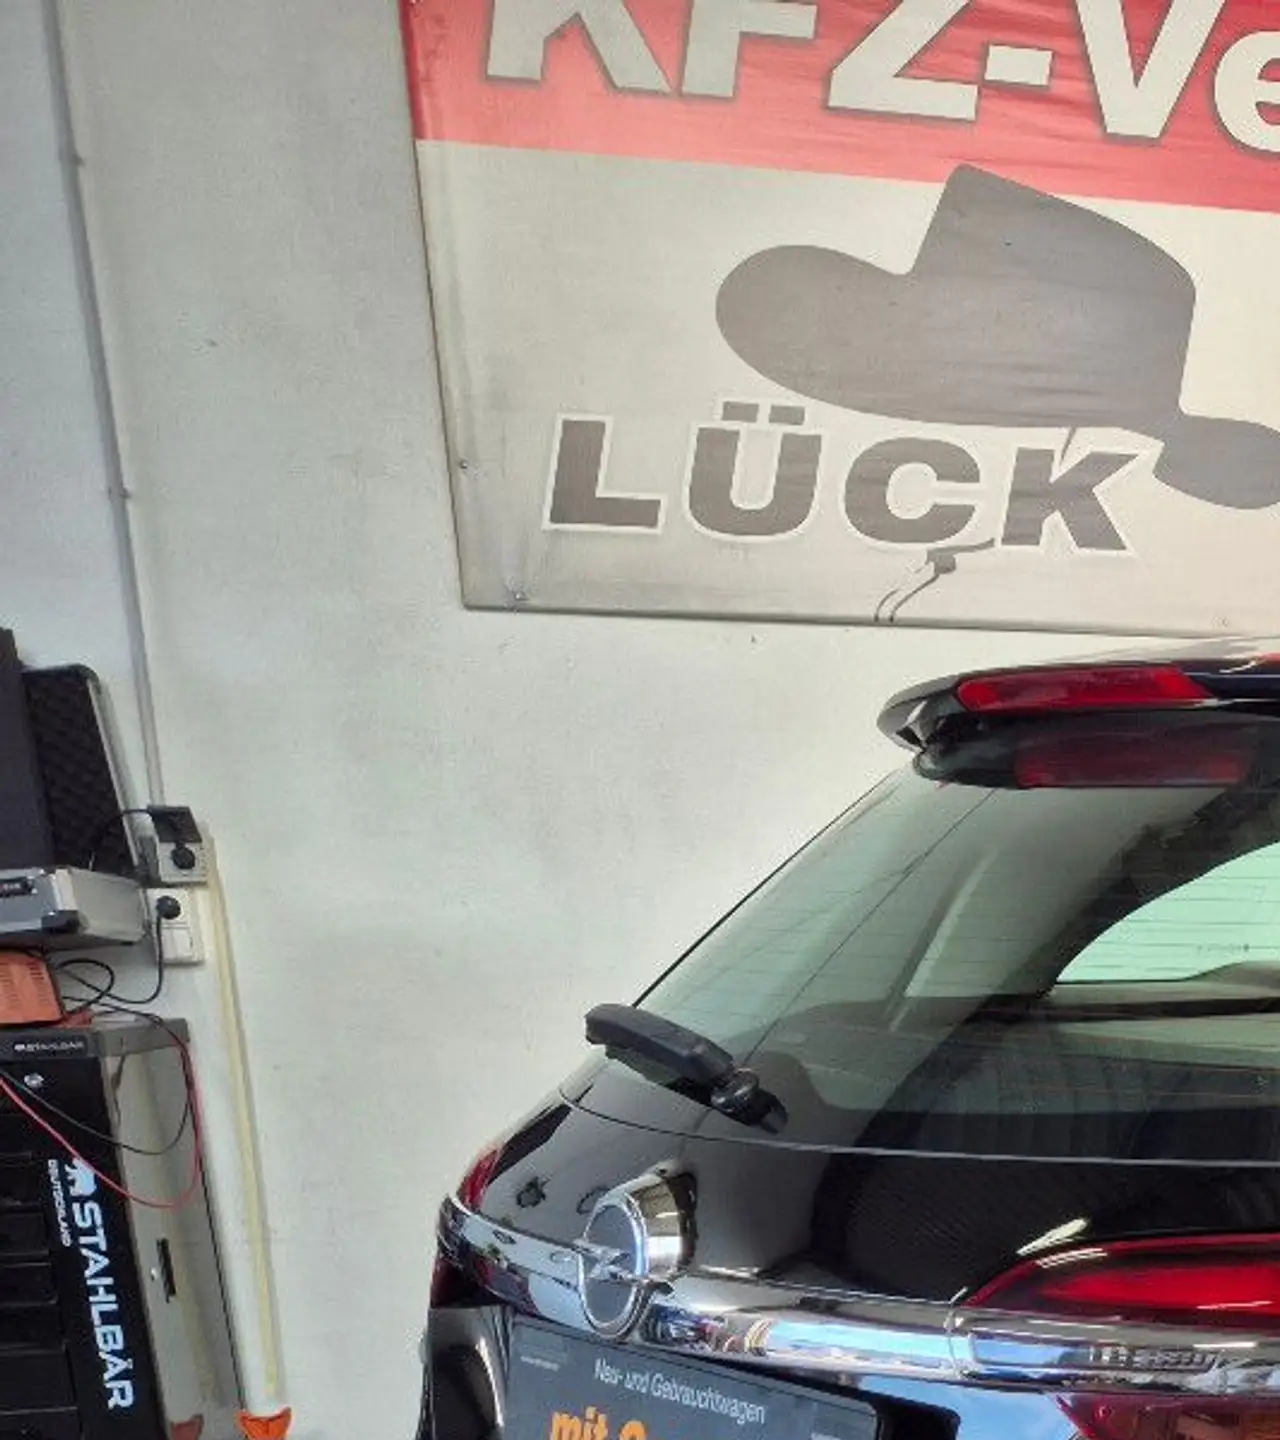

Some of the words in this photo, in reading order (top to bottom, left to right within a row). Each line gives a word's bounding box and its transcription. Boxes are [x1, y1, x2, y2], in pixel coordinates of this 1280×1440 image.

[549, 402, 1138, 552] LÜCK
[72, 1200, 134, 1410] STAHLBÄR
[594, 1358, 623, 1385] Neu-
[623, 1370, 649, 1393] und
[651, 1373, 766, 1424] Gebrauchtwagen
